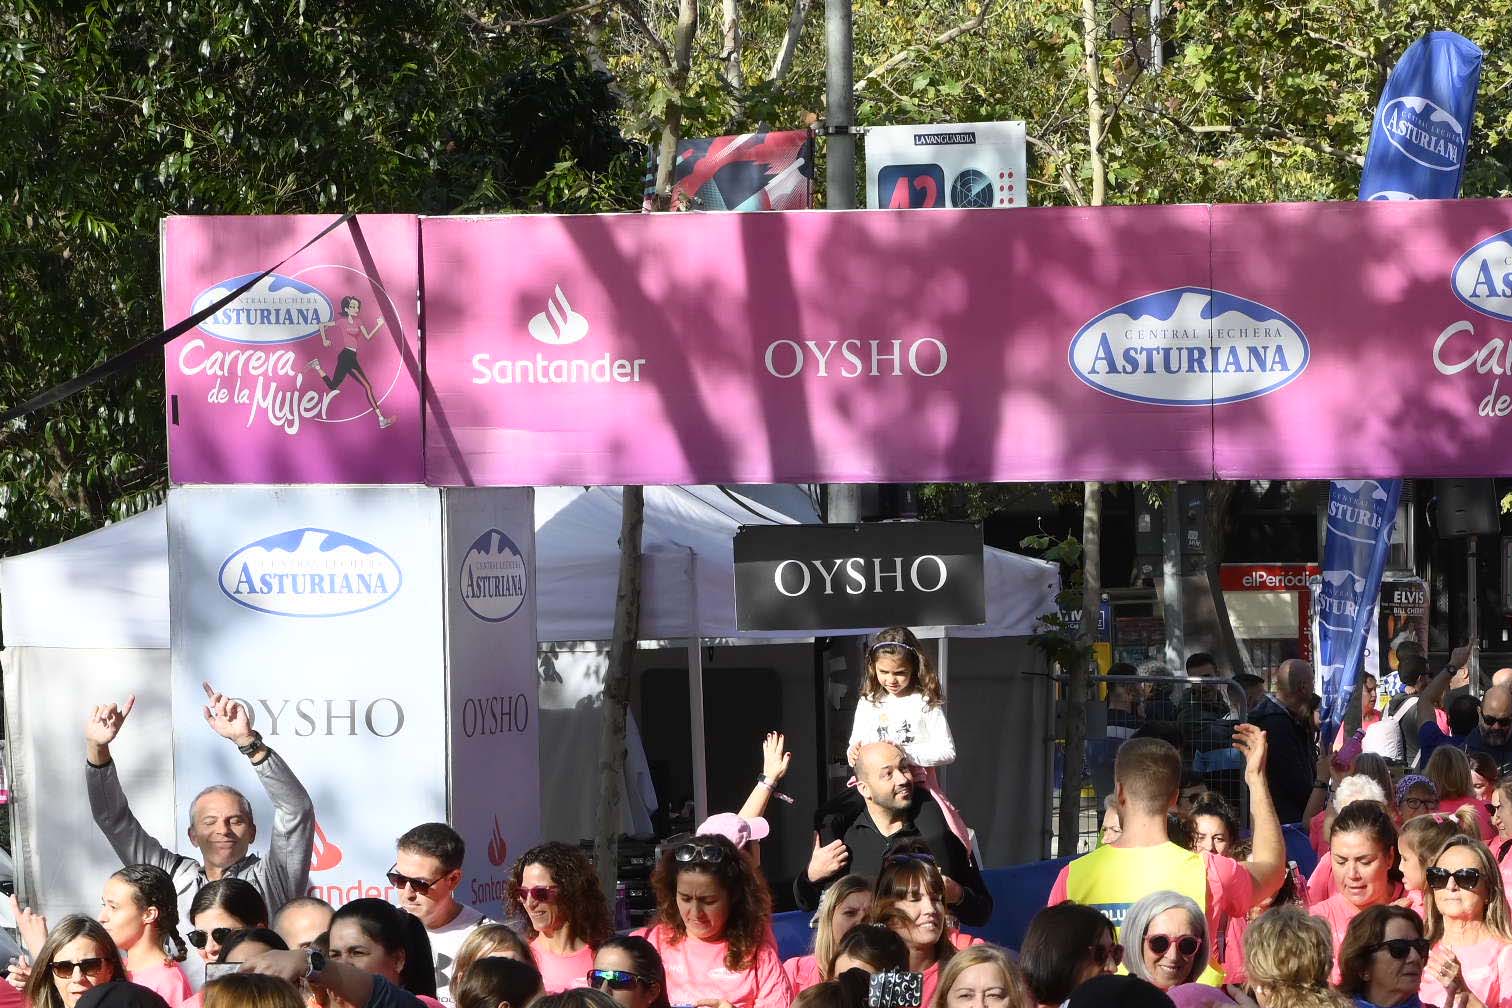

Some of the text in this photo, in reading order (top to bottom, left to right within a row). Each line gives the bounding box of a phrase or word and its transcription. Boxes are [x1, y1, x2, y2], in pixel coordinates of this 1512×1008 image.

[1087, 331, 1291, 375] ASTURIANA
[1124, 326, 1283, 341] CENTRAL LECHERA
[178, 339, 297, 377] Carrera
[472, 352, 646, 385] Santander
[764, 336, 949, 379] OYSHO
[207, 373, 341, 435] de la Mujer
[1478, 378, 1512, 418] de
[233, 561, 389, 595] ASTURIANA
[465, 563, 524, 600] ASTURIANA
[773, 554, 948, 597] OYSHO
[1393, 590, 1424, 604] ELVIS
[461, 693, 529, 739] OYSHO
